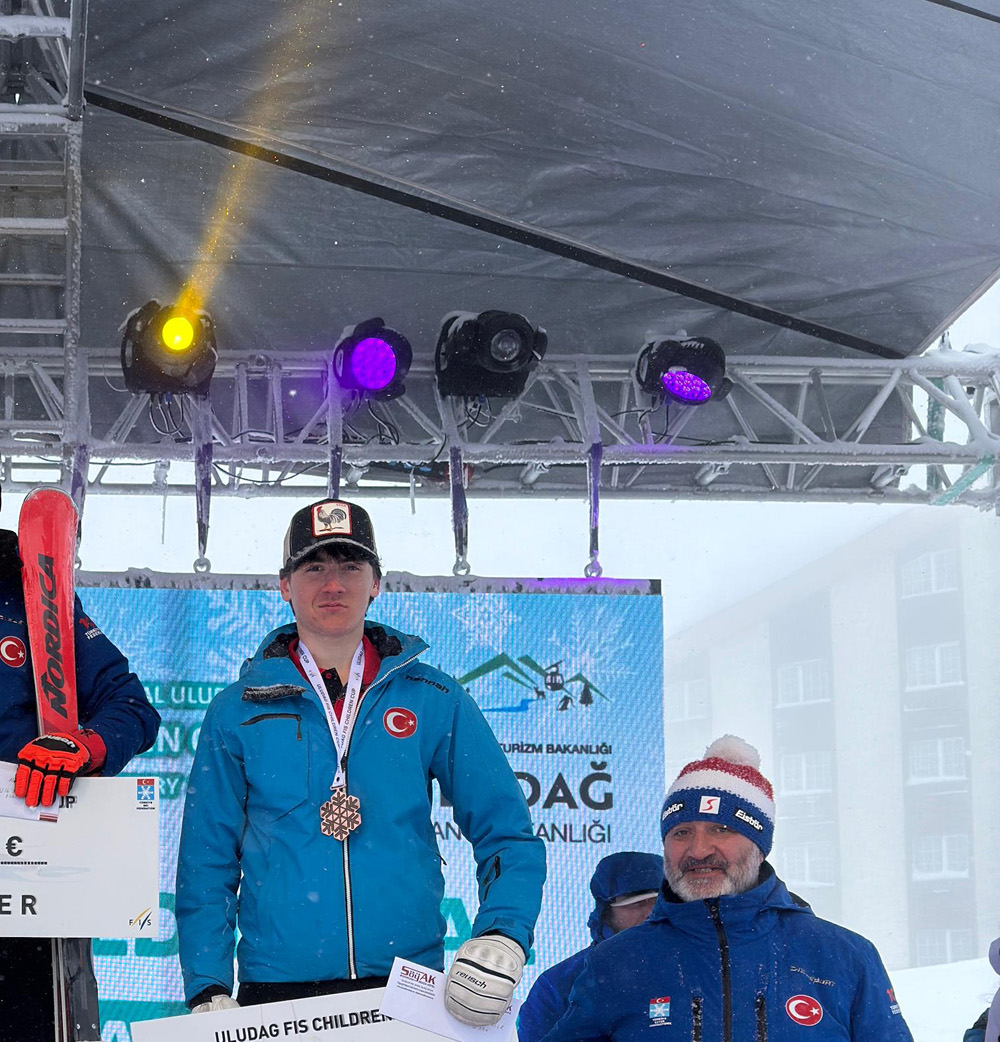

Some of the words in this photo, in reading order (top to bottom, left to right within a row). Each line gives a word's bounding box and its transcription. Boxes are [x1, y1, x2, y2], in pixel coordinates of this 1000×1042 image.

[38, 553, 68, 720] NORDICA
[344, 700, 353, 725] CHILDREN
[546, 742, 612, 755] BAKANLIĞI
[514, 761, 614, 811] DAĞ
[735, 809, 763, 831] Eisbär
[536, 820, 611, 844] ANLIĞI
[5, 834, 23, 857] €
[455, 970, 487, 989] reusch
[283, 1018, 308, 1036] FIS
